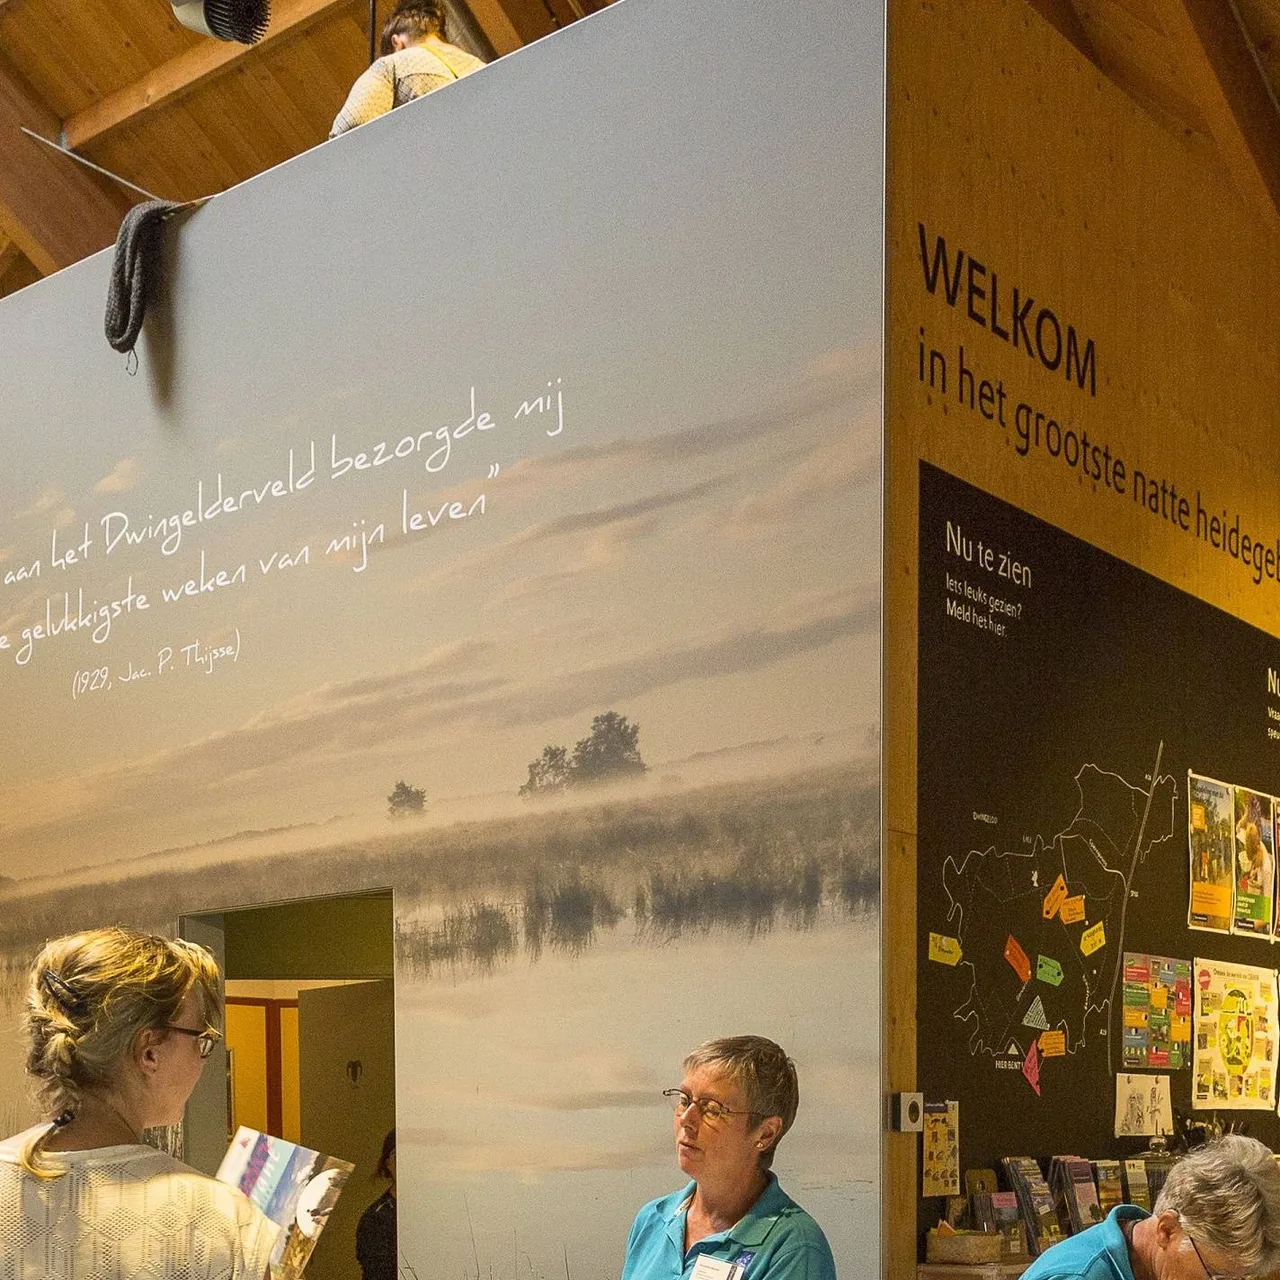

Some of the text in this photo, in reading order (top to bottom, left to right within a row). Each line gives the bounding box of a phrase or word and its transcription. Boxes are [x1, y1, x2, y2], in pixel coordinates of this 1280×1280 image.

[918, 223, 1097, 397] WELKOM
[919, 326, 947, 394] in
[958, 345, 1008, 429] het
[1015, 402, 1127, 495] grootste
[1133, 469, 1191, 531] natte
[3, 559, 41, 585] aan
[51, 521, 94, 570] het
[100, 440, 316, 556] Dwingelderveld
[330, 385, 497, 480] bezorgde
[514, 376, 564, 437] mij
[946, 520, 1032, 589] Nu te zien
[14, 575, 151, 666] gelukkigste
[161, 550, 246, 603] weken
[259, 545, 310, 575] van
[325, 519, 385, 573] mijn
[946, 571, 1023, 620] Iets leuks gezien?
[946, 596, 971, 623] Meld
[971, 606, 989, 630] het
[118, 661, 152, 683] Jac.
[157, 646, 175, 675] P.
[995, 1059, 1009, 1069] HIER
